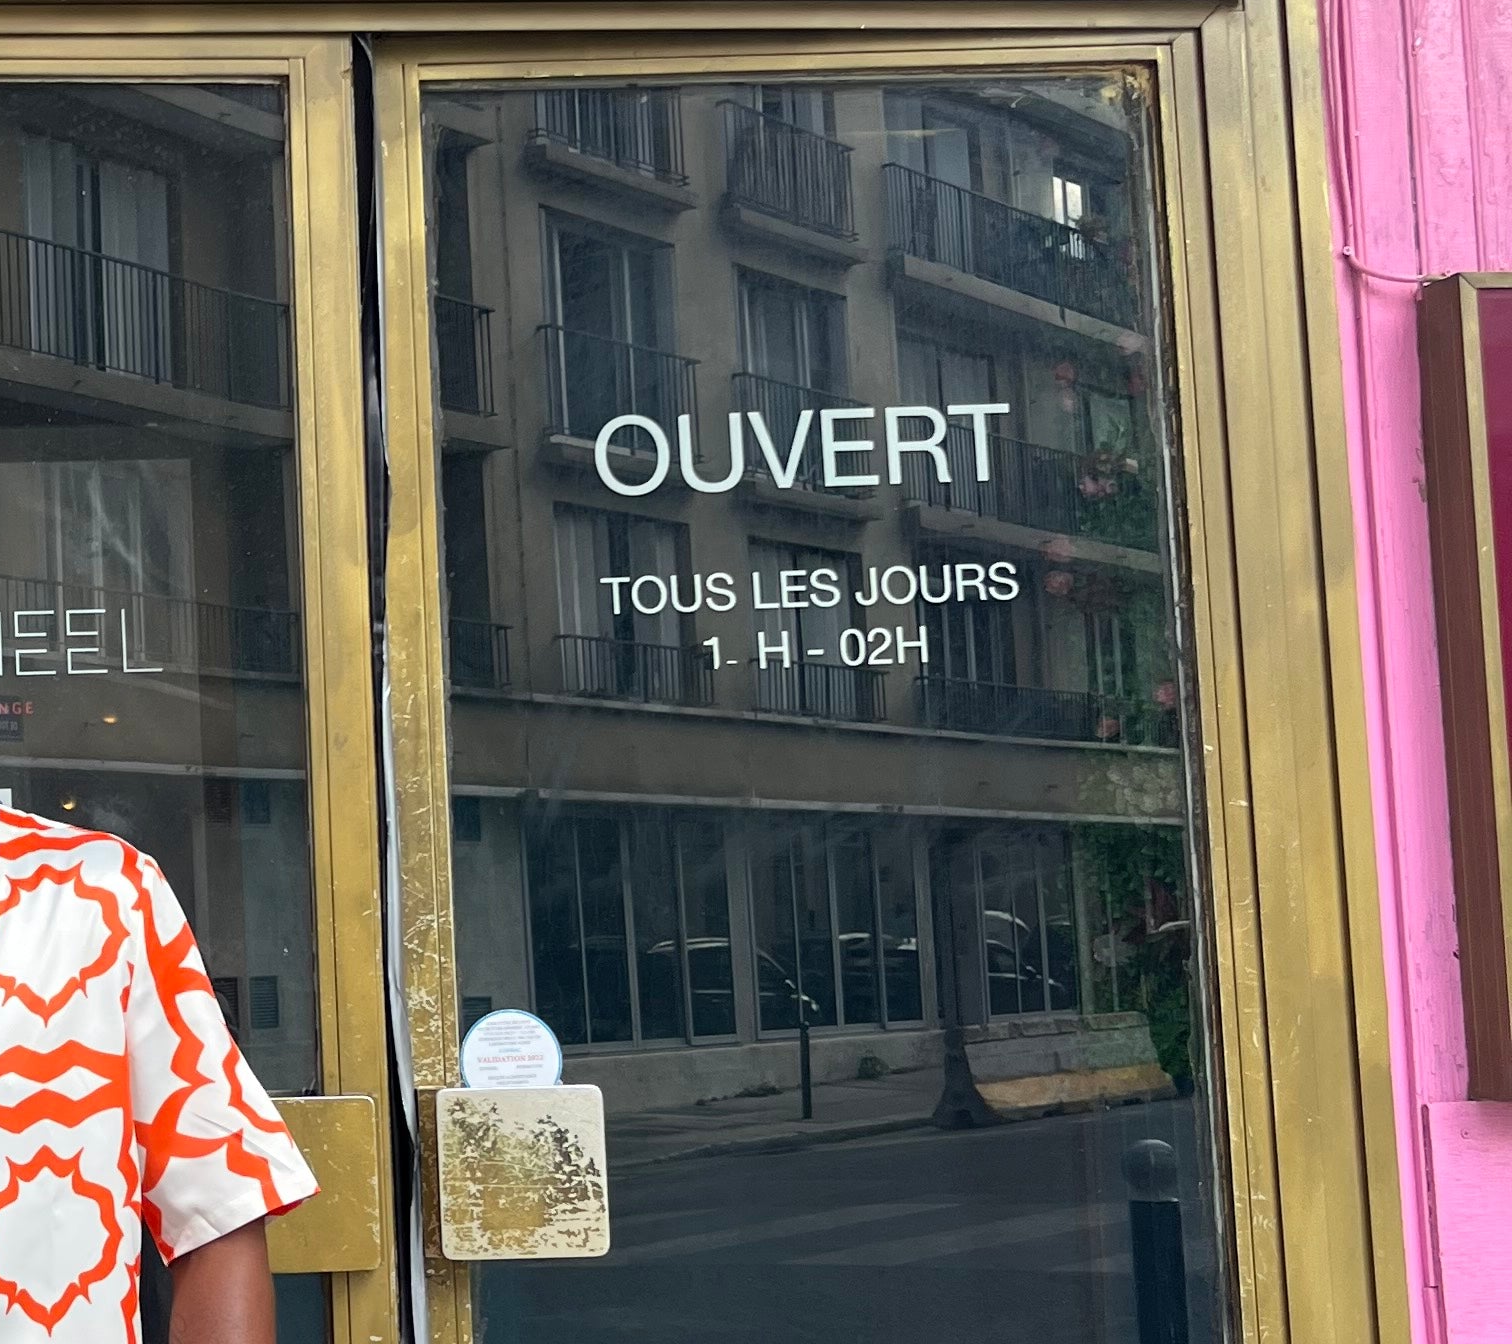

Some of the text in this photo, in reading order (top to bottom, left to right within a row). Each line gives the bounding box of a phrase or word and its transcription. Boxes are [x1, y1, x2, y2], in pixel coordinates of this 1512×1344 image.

[594, 403, 1010, 496] OUVERT
[599, 561, 1019, 615] TOUS LES JOURS
[839, 625, 929, 666] 02H
[476, 1055, 526, 1064] VALIDATION
